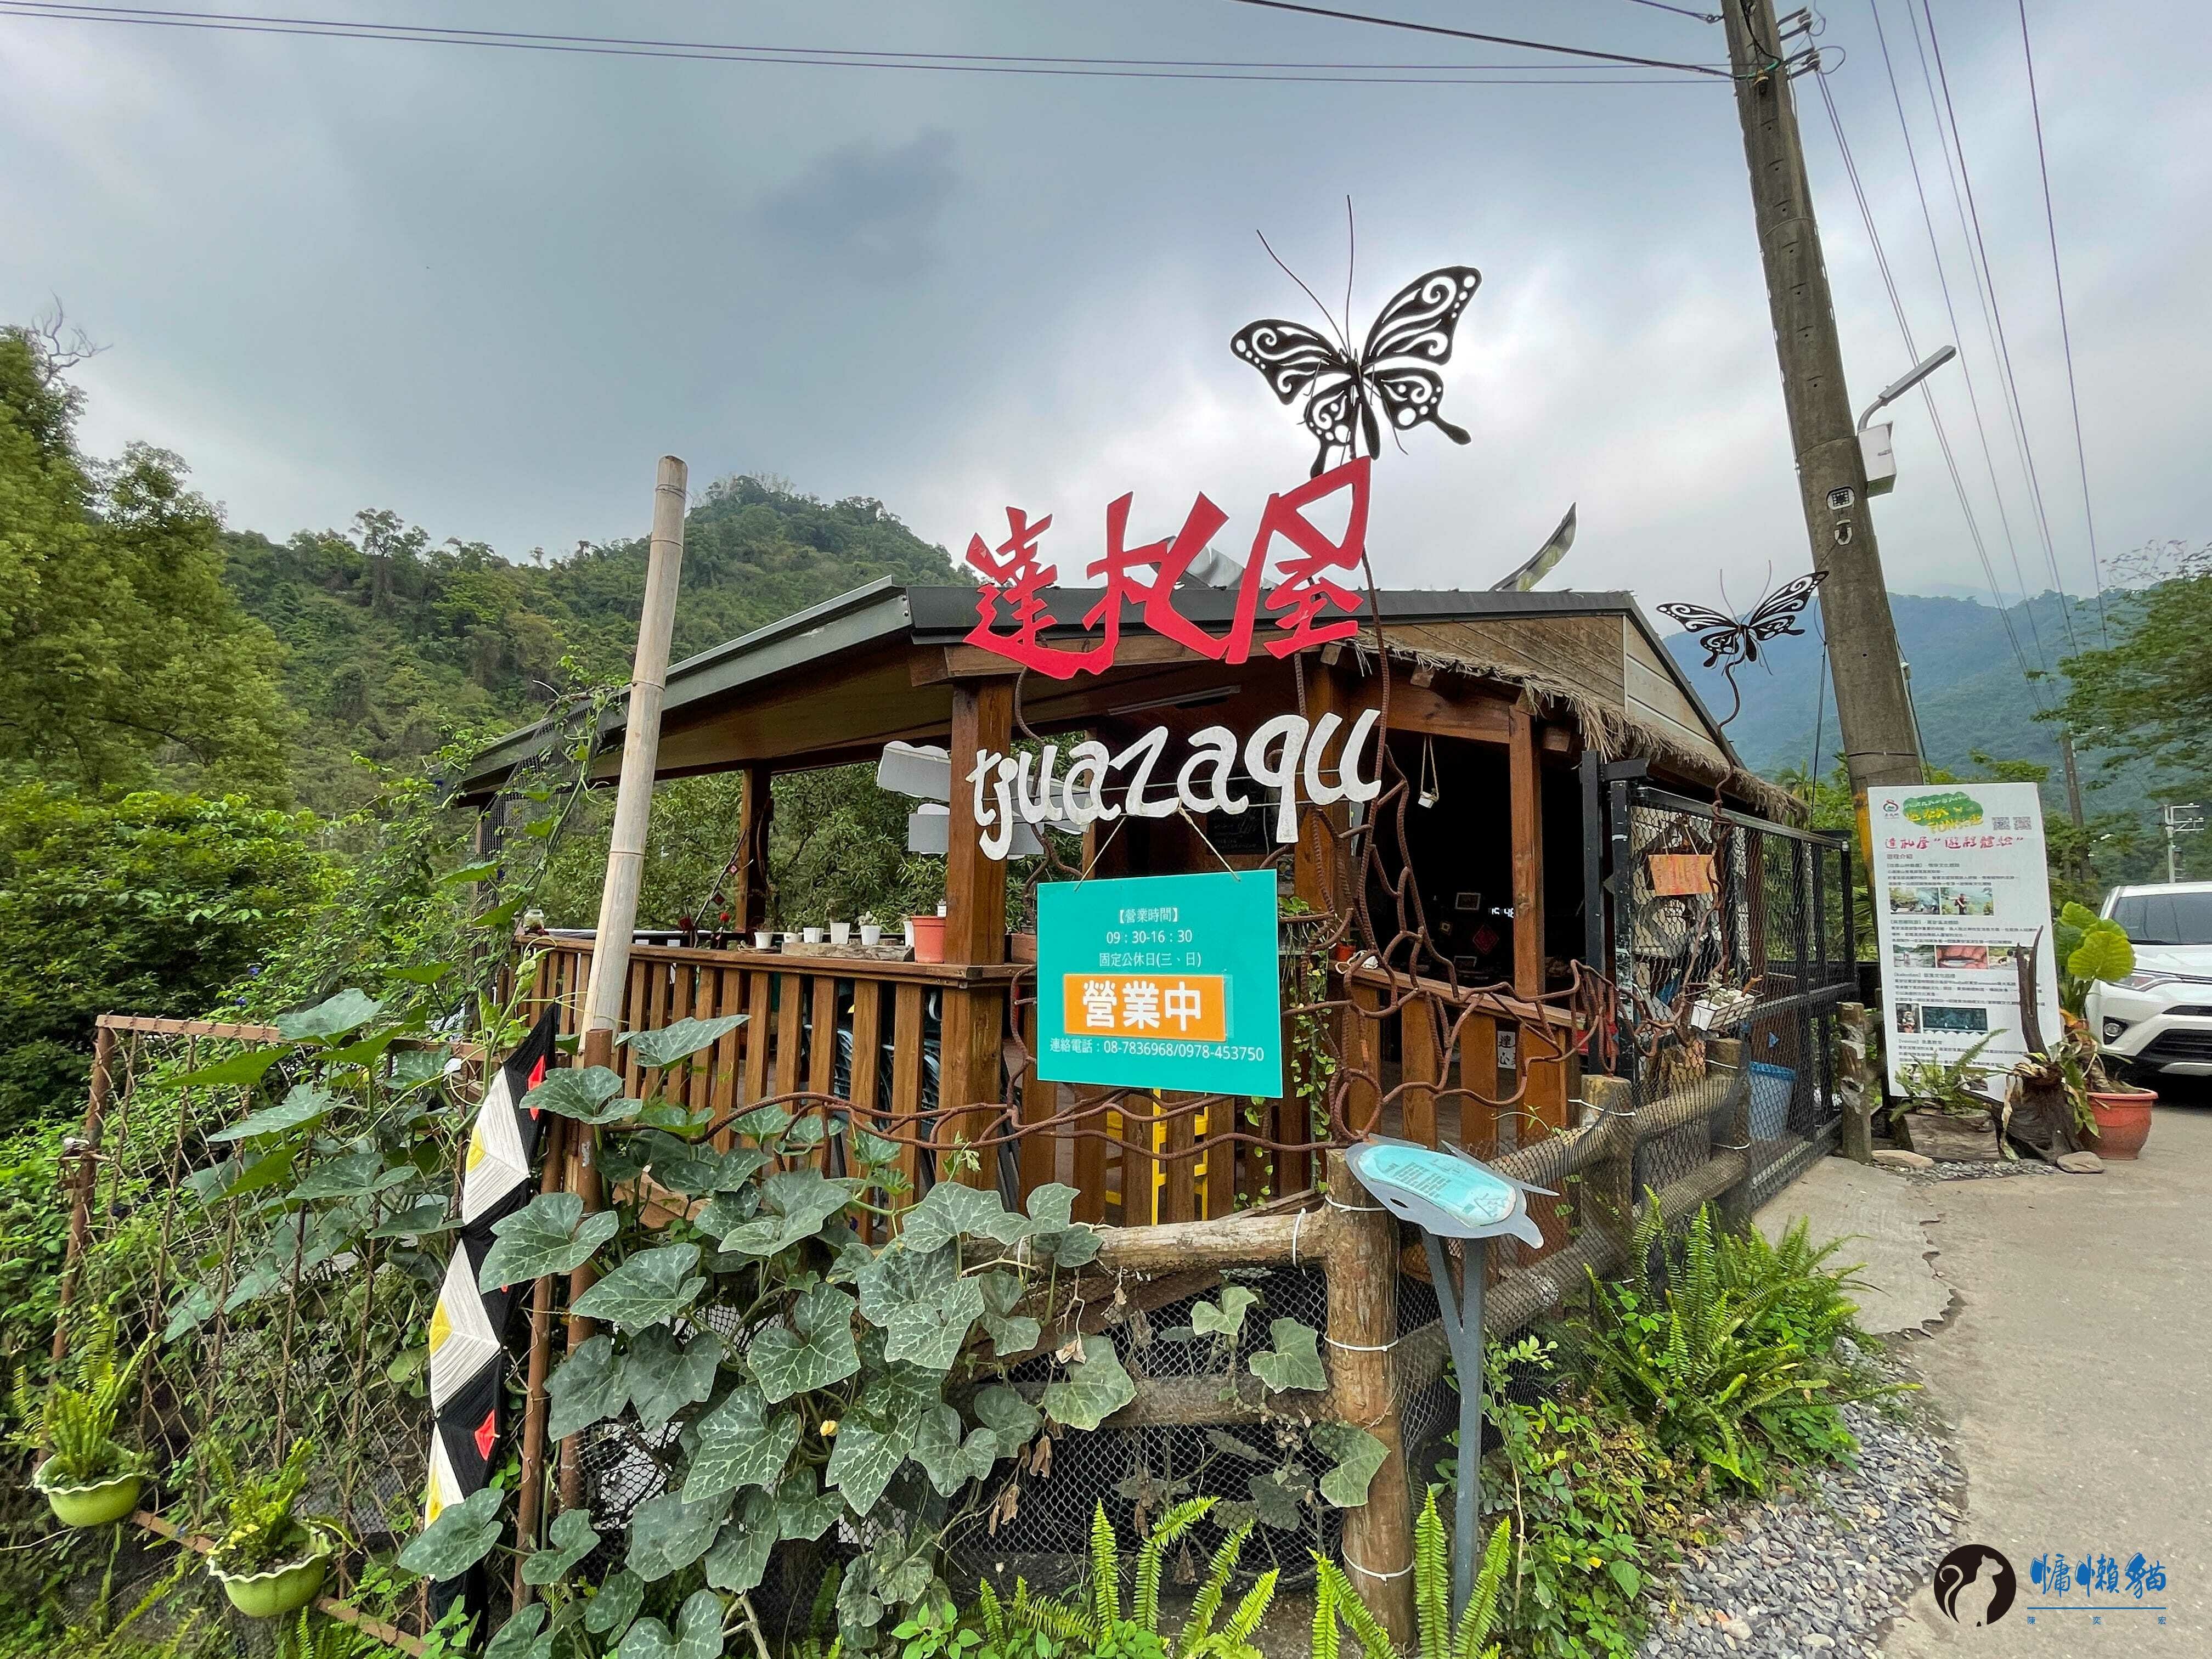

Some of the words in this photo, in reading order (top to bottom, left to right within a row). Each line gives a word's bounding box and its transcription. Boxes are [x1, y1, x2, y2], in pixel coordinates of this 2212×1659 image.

[965, 709, 1381, 860] tjuazaqu
[1120, 907, 1178, 923] 【營業時間】
[1083, 980, 1201, 1032] 營業中
